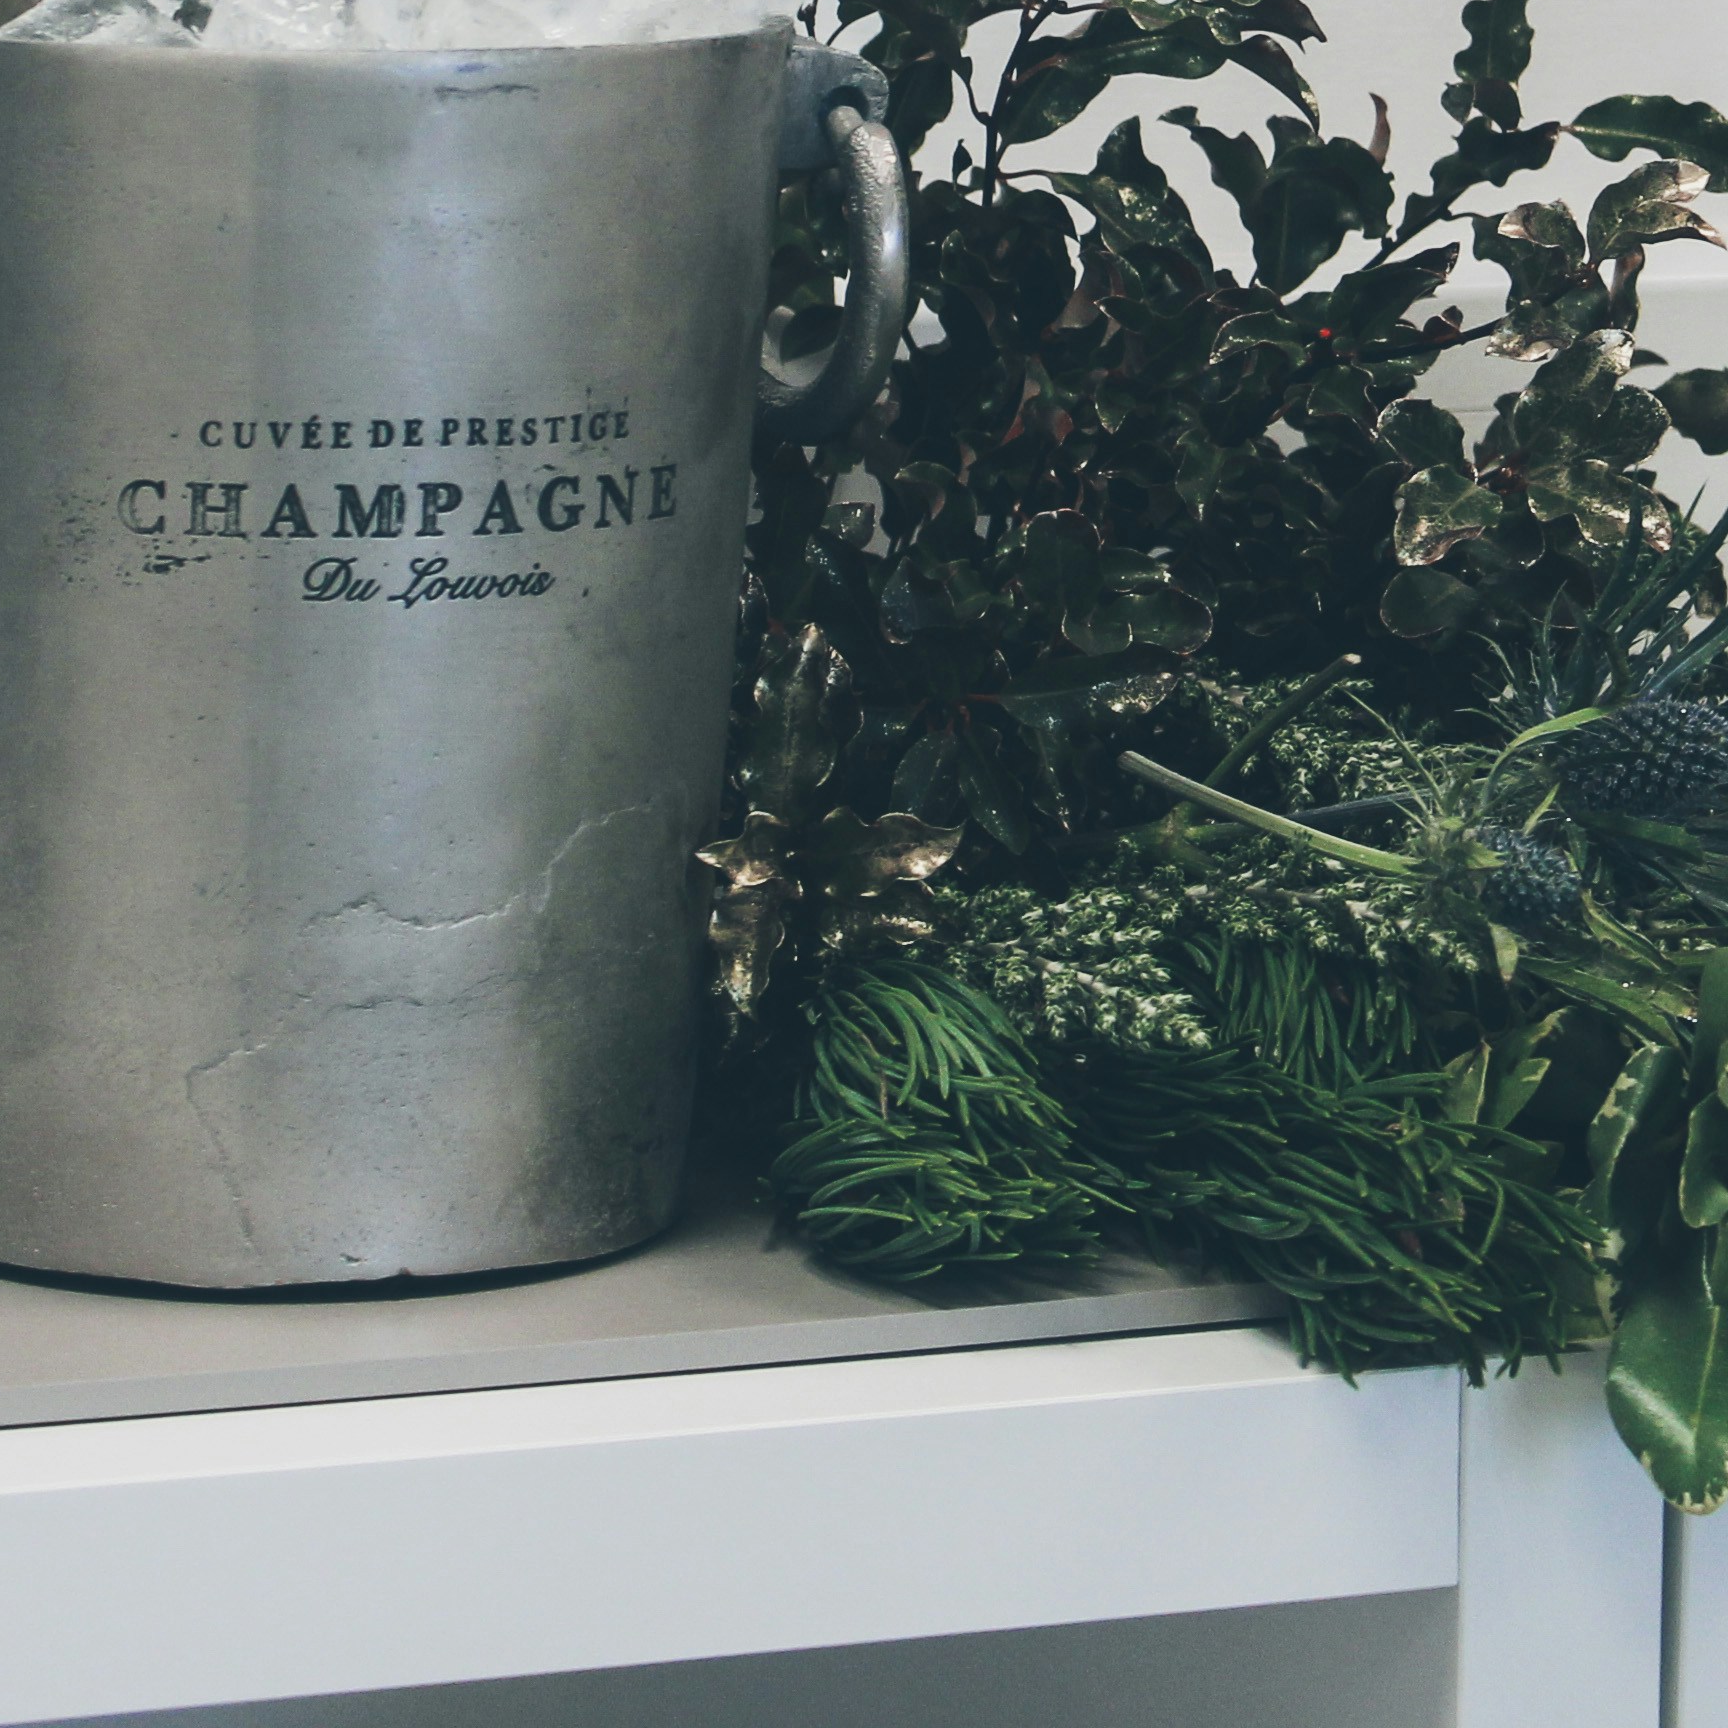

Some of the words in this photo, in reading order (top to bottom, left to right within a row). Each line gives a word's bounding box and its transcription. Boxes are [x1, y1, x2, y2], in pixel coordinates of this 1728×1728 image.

[198, 414, 353, 450] CUVÉE
[368, 417, 424, 448] DE
[440, 410, 630, 448] PRESTIGE
[117, 462, 679, 539] CHAMPAGNE
[302, 556, 381, 603] Du
[386, 556, 556, 609] Louvois
